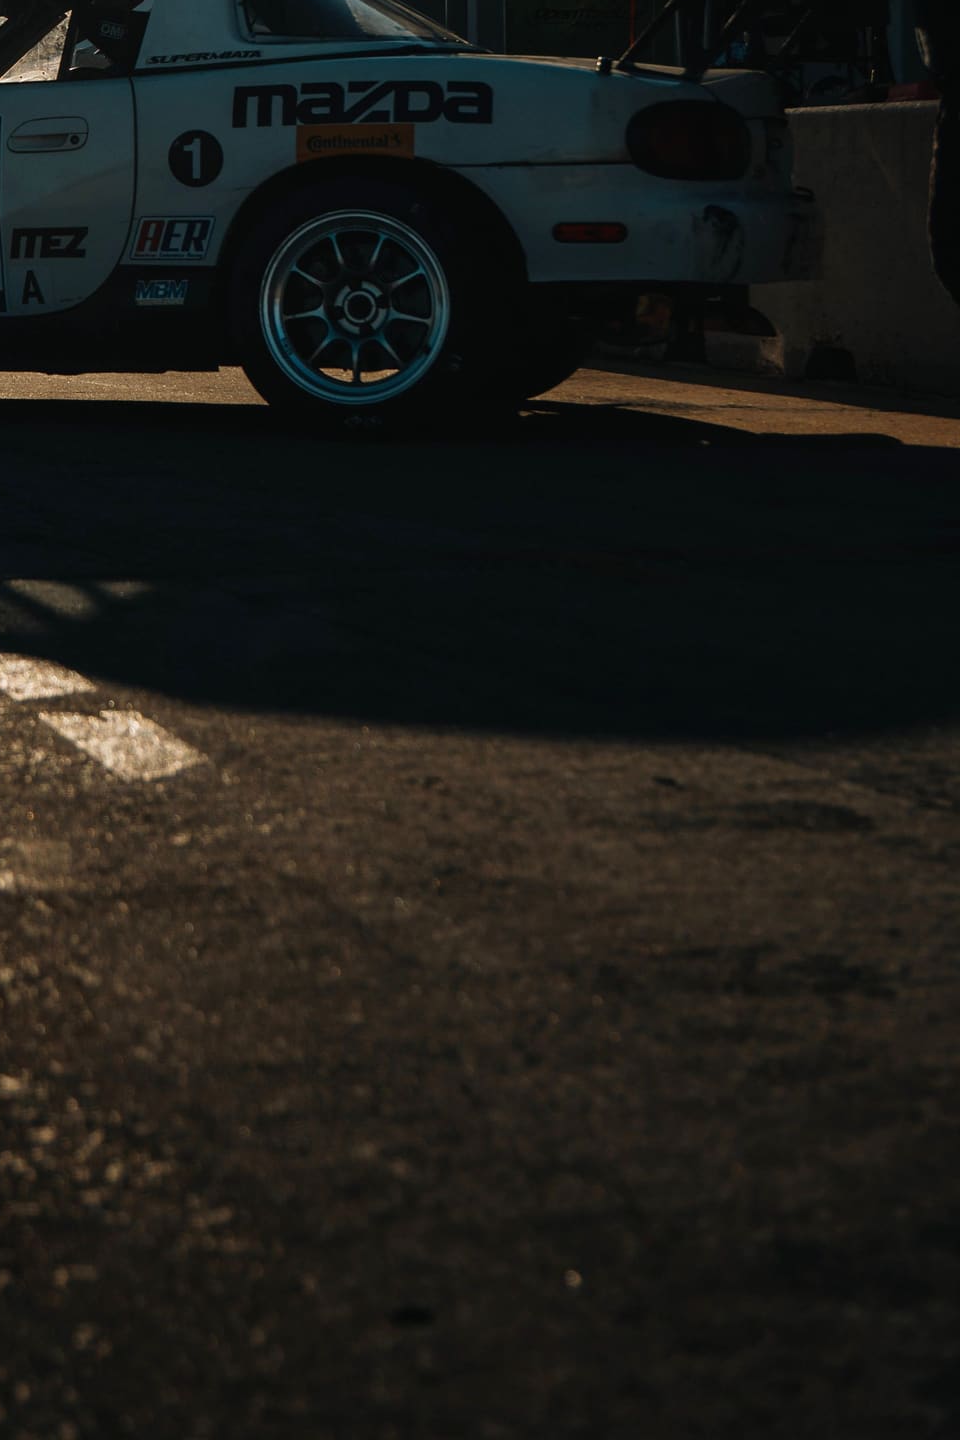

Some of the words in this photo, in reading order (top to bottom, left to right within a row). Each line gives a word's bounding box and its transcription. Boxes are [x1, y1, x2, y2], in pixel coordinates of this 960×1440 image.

[183, 137, 202, 180] 1
[306, 134, 388, 153] Continental
[136, 220, 211, 252] AER
[22, 270, 45, 305] A
